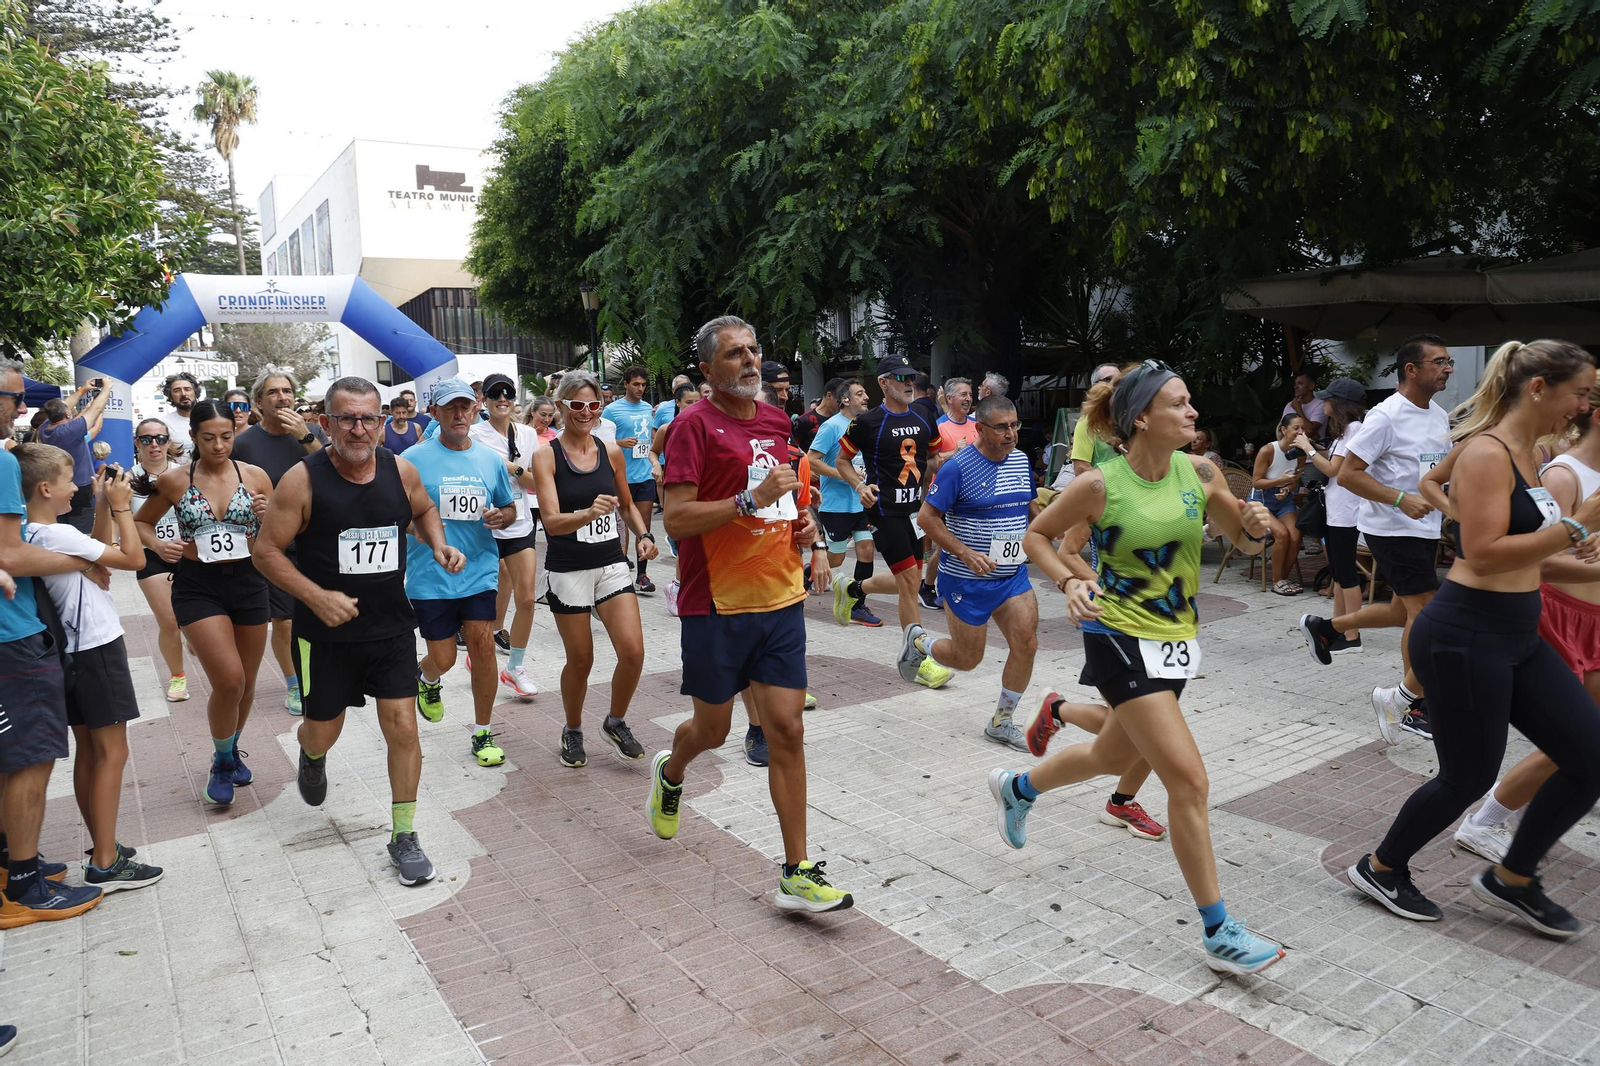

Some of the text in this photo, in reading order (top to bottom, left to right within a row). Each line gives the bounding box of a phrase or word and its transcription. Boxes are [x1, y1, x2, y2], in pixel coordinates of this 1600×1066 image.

[388, 190, 434, 201] TEATRO
[218, 295, 326, 310] CRONOFINISHER
[892, 426, 921, 437] STOP
[449, 495, 479, 514] 190
[156, 524, 176, 540] 55
[586, 515, 611, 537] 188
[210, 532, 235, 553] 53
[1002, 541, 1020, 558] 80
[351, 540, 389, 565] 177
[1161, 640, 1190, 668] 23
